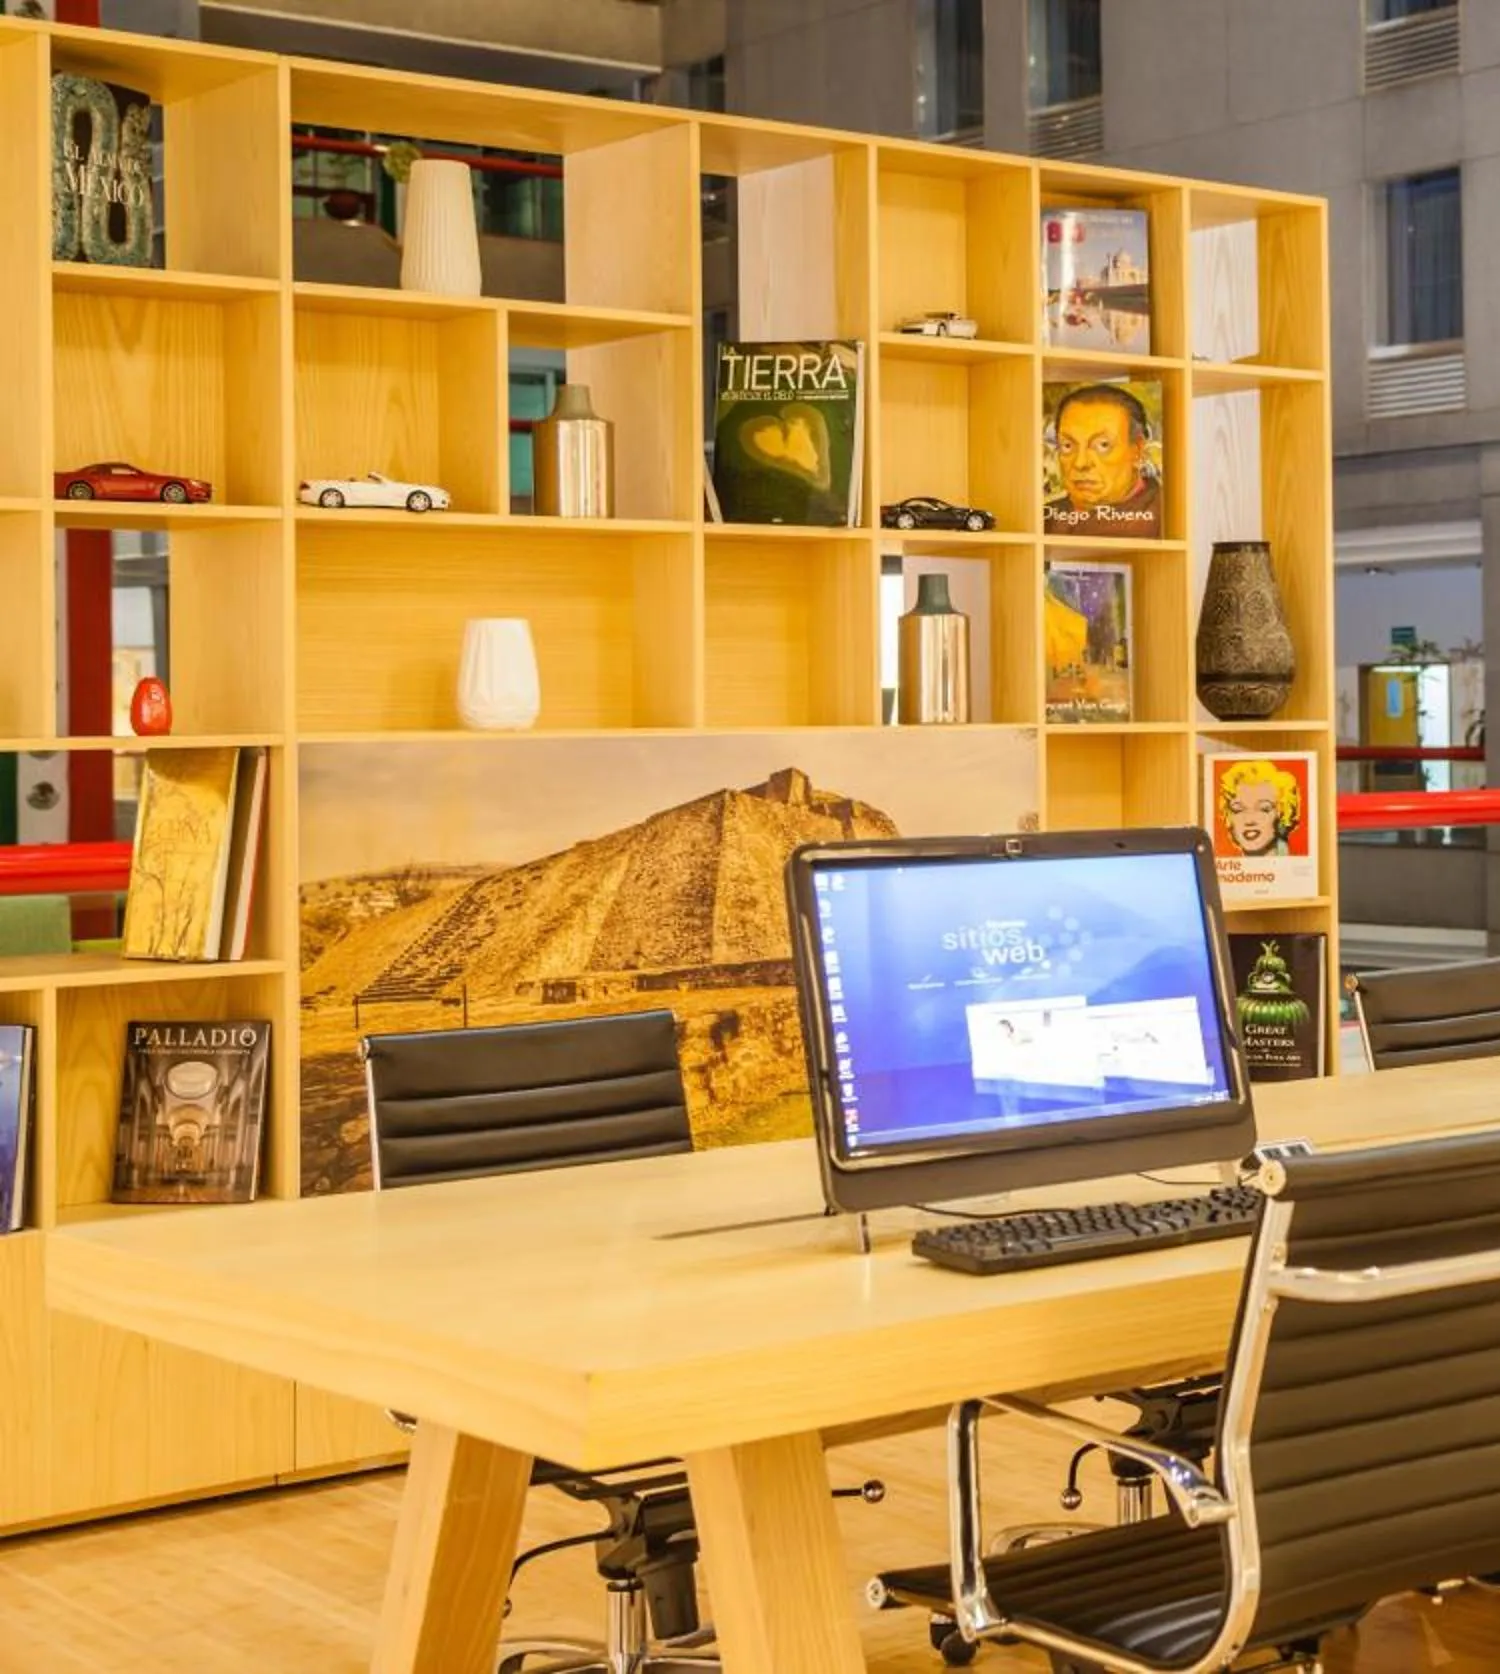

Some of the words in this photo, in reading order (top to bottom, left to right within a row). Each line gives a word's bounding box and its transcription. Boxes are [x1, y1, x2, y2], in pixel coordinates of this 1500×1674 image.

[721, 353, 848, 391] TIERRA
[1043, 505, 1090, 525] Diego
[1095, 505, 1154, 521] Rivera
[1215, 859, 1242, 871] Arte
[941, 925, 1023, 950] sitios
[981, 938, 1045, 966] web
[133, 1027, 257, 1047] PALLADIO
